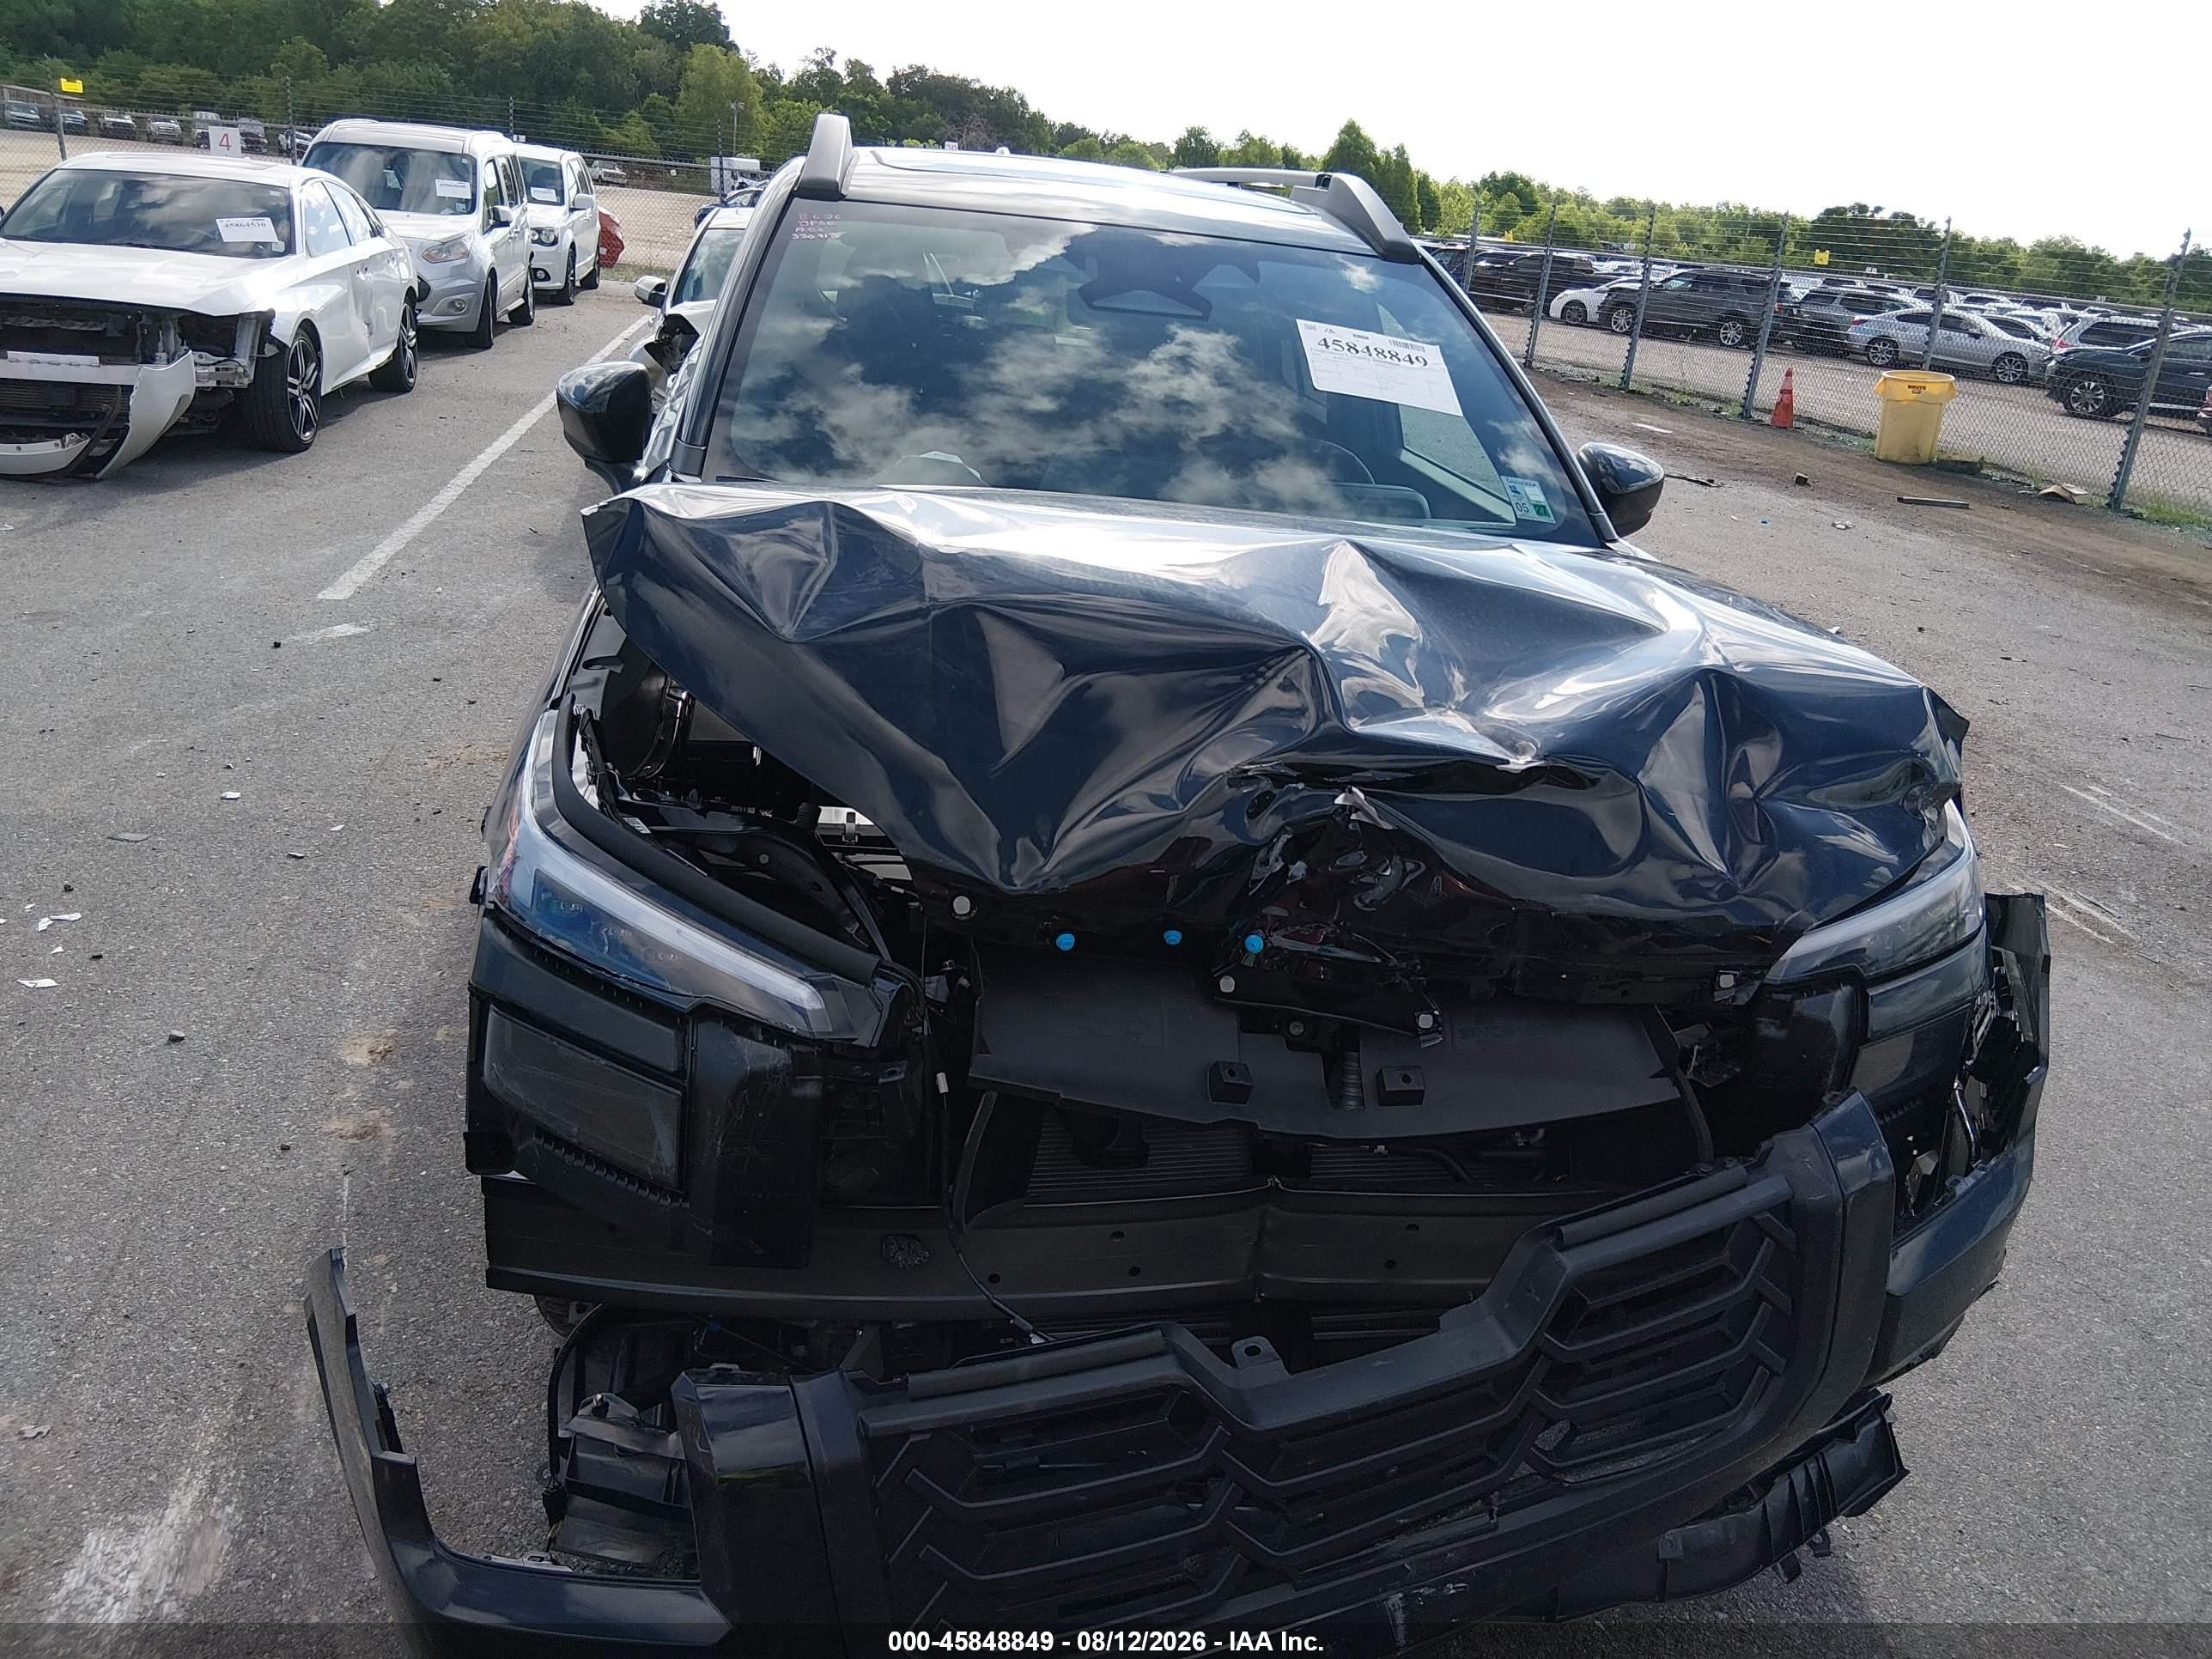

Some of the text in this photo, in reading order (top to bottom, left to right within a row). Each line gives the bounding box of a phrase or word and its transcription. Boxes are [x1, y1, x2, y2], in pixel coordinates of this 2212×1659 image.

[219, 133, 232, 151] 4
[1317, 337, 1429, 368] 45848849
[1515, 501, 1529, 513] 05
